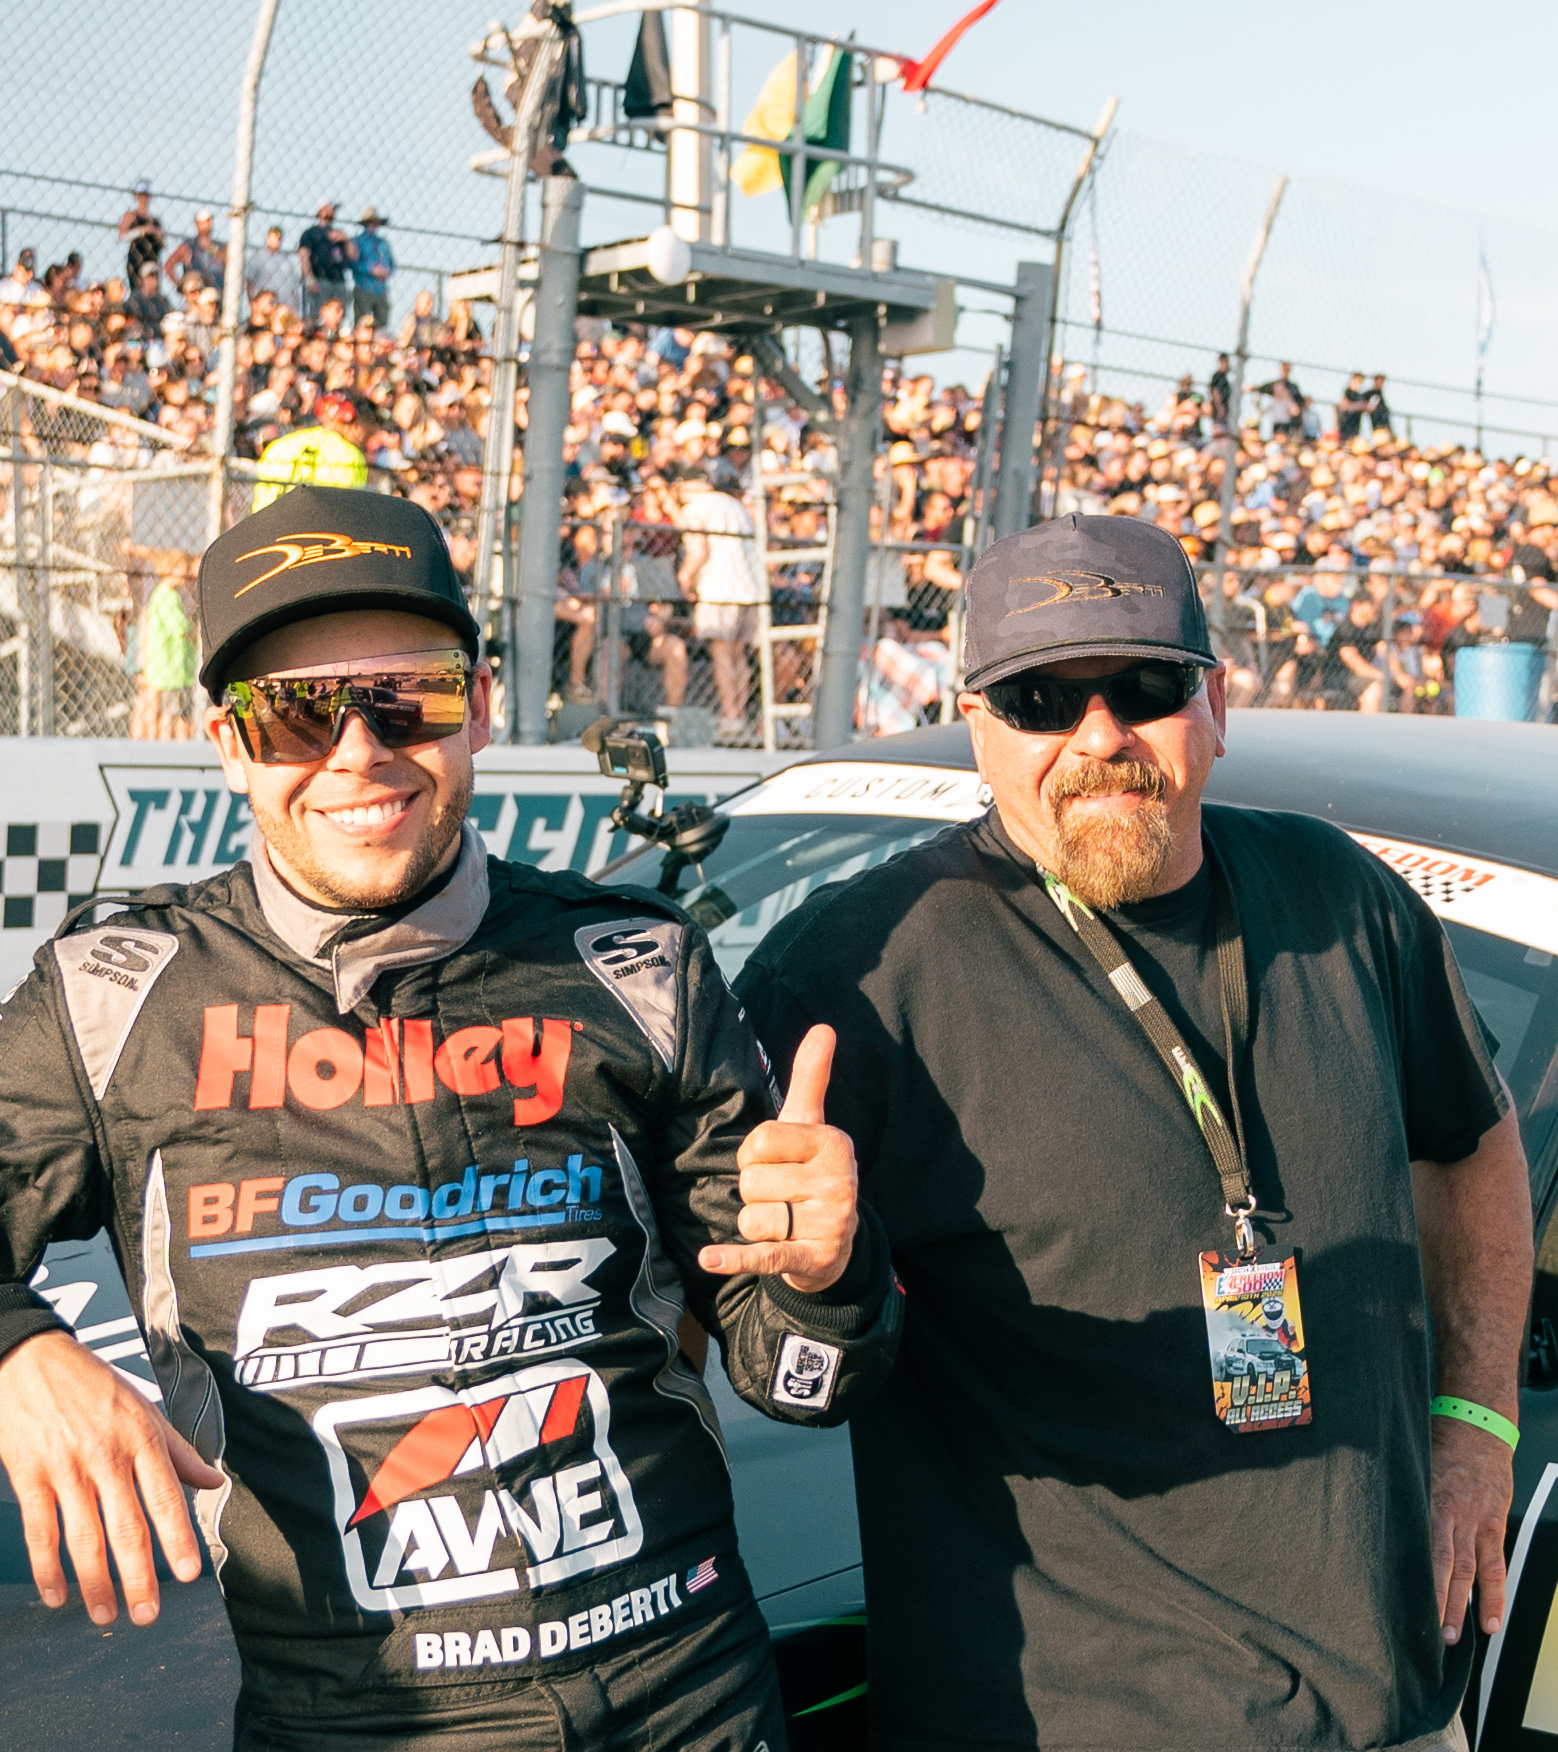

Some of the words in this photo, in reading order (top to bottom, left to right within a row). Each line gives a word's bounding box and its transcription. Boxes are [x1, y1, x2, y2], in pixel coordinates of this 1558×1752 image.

[120, 789, 251, 866] THE
[805, 778, 959, 801] CUSTOM
[194, 1003, 572, 1126] Holley
[188, 1154, 602, 1239] BFGoodrich
[566, 1204, 602, 1223] Tires
[234, 1237, 617, 1360] RZR
[458, 1311, 595, 1364] RACING
[1226, 1407, 1246, 1425] ALL
[1250, 1400, 1302, 1422] ACCESS
[372, 1460, 614, 1586] AWE
[415, 1626, 531, 1670] BRAD
[539, 1573, 683, 1658] DEBERTI
